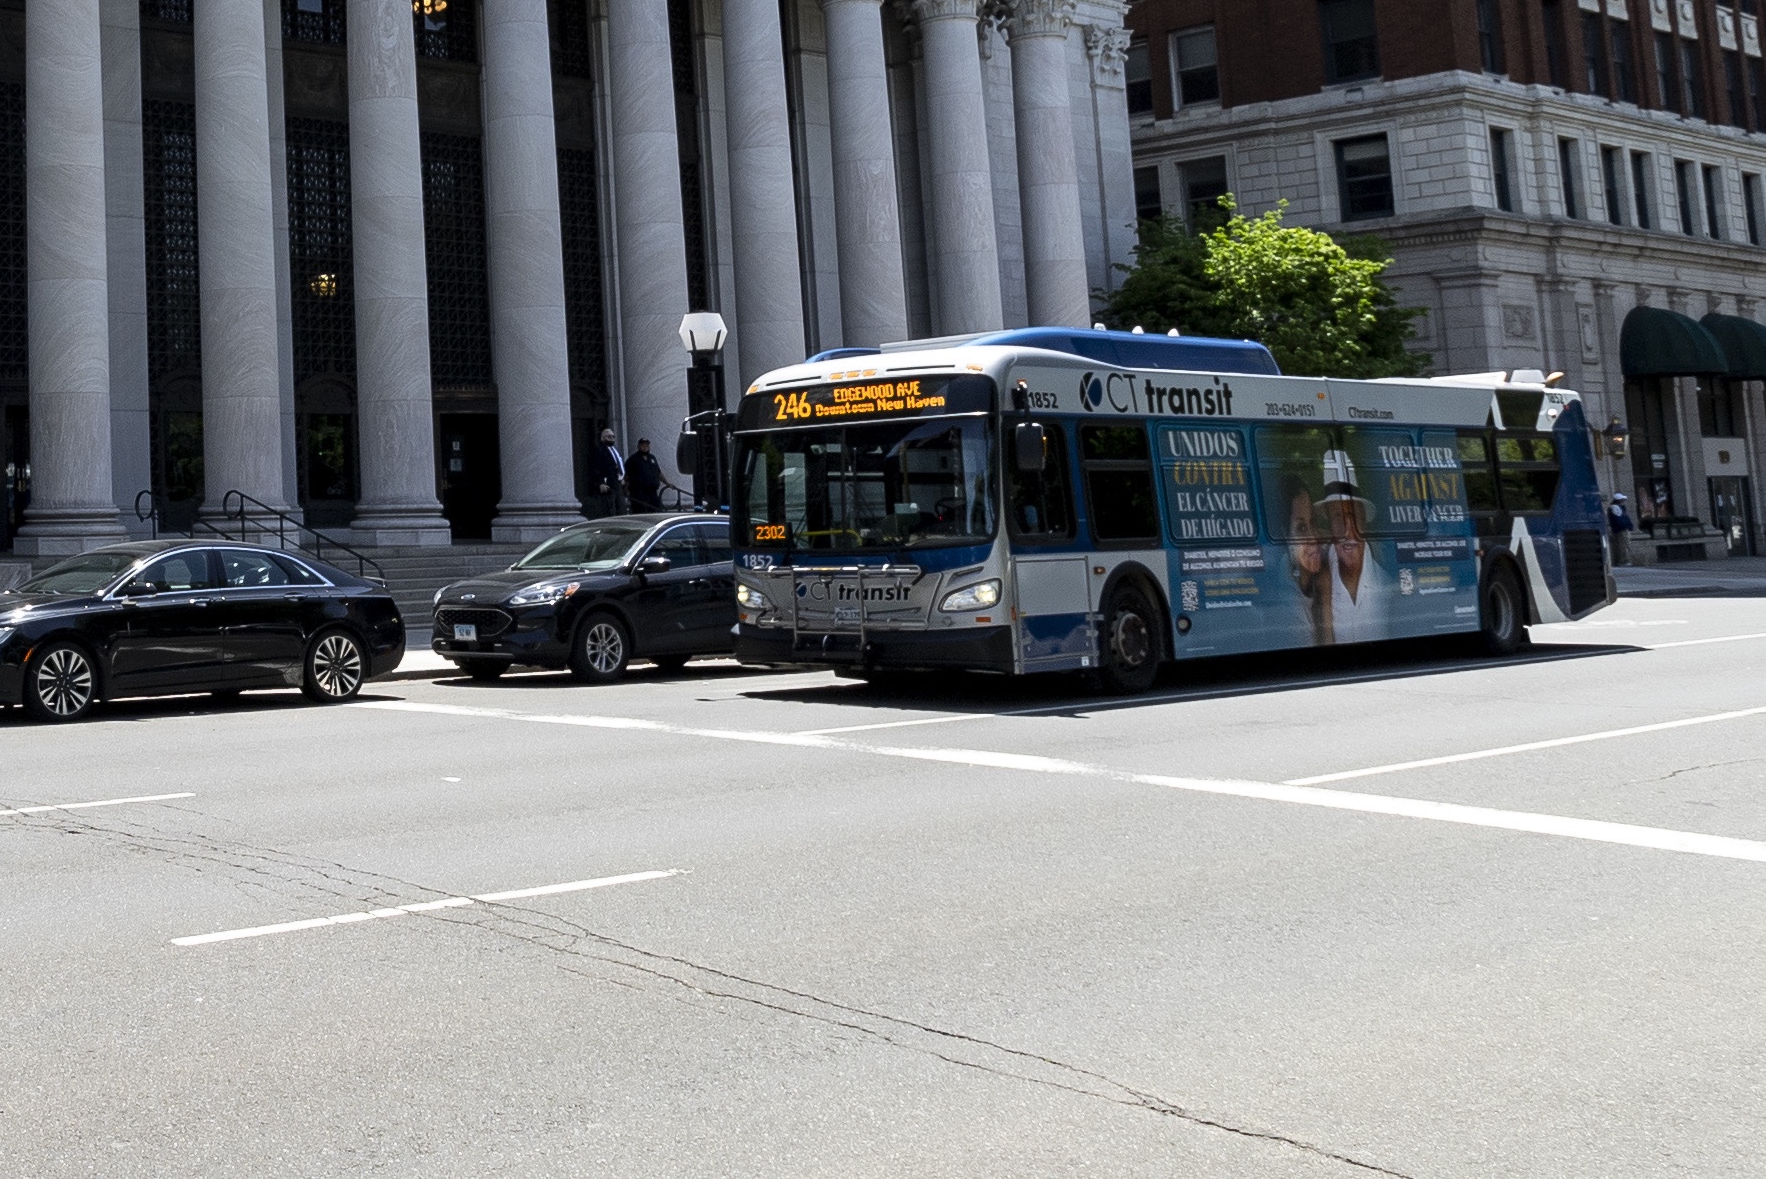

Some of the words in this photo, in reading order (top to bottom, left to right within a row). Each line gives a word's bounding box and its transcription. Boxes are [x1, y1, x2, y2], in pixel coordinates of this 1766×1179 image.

[834, 384, 894, 403] EDGEWOOD
[896, 381, 921, 397] AVE
[1028, 391, 1059, 409] 1852
[1106, 373, 1138, 413] CT
[1145, 376, 1233, 416] transit
[773, 391, 812, 420] 246
[815, 402, 874, 417] Downtown
[877, 399, 904, 411] New
[906, 396, 945, 409] Haven
[1168, 431, 1238, 457] UNIDOS
[1378, 446, 1457, 468] TOGETHER
[1174, 461, 1244, 485] CONTRA
[1390, 473, 1459, 500] AGAINST
[1177, 492, 1195, 511] EL
[1196, 488, 1249, 511] CÁNCER
[1389, 505, 1422, 522] LIVER
[755, 525, 785, 540] 2302
[1181, 519, 1201, 539] DE
[1202, 514, 1254, 538] HÍGADO
[742, 554, 773, 568] 1852
[810, 581, 832, 601] CT
[838, 582, 911, 601] transit
